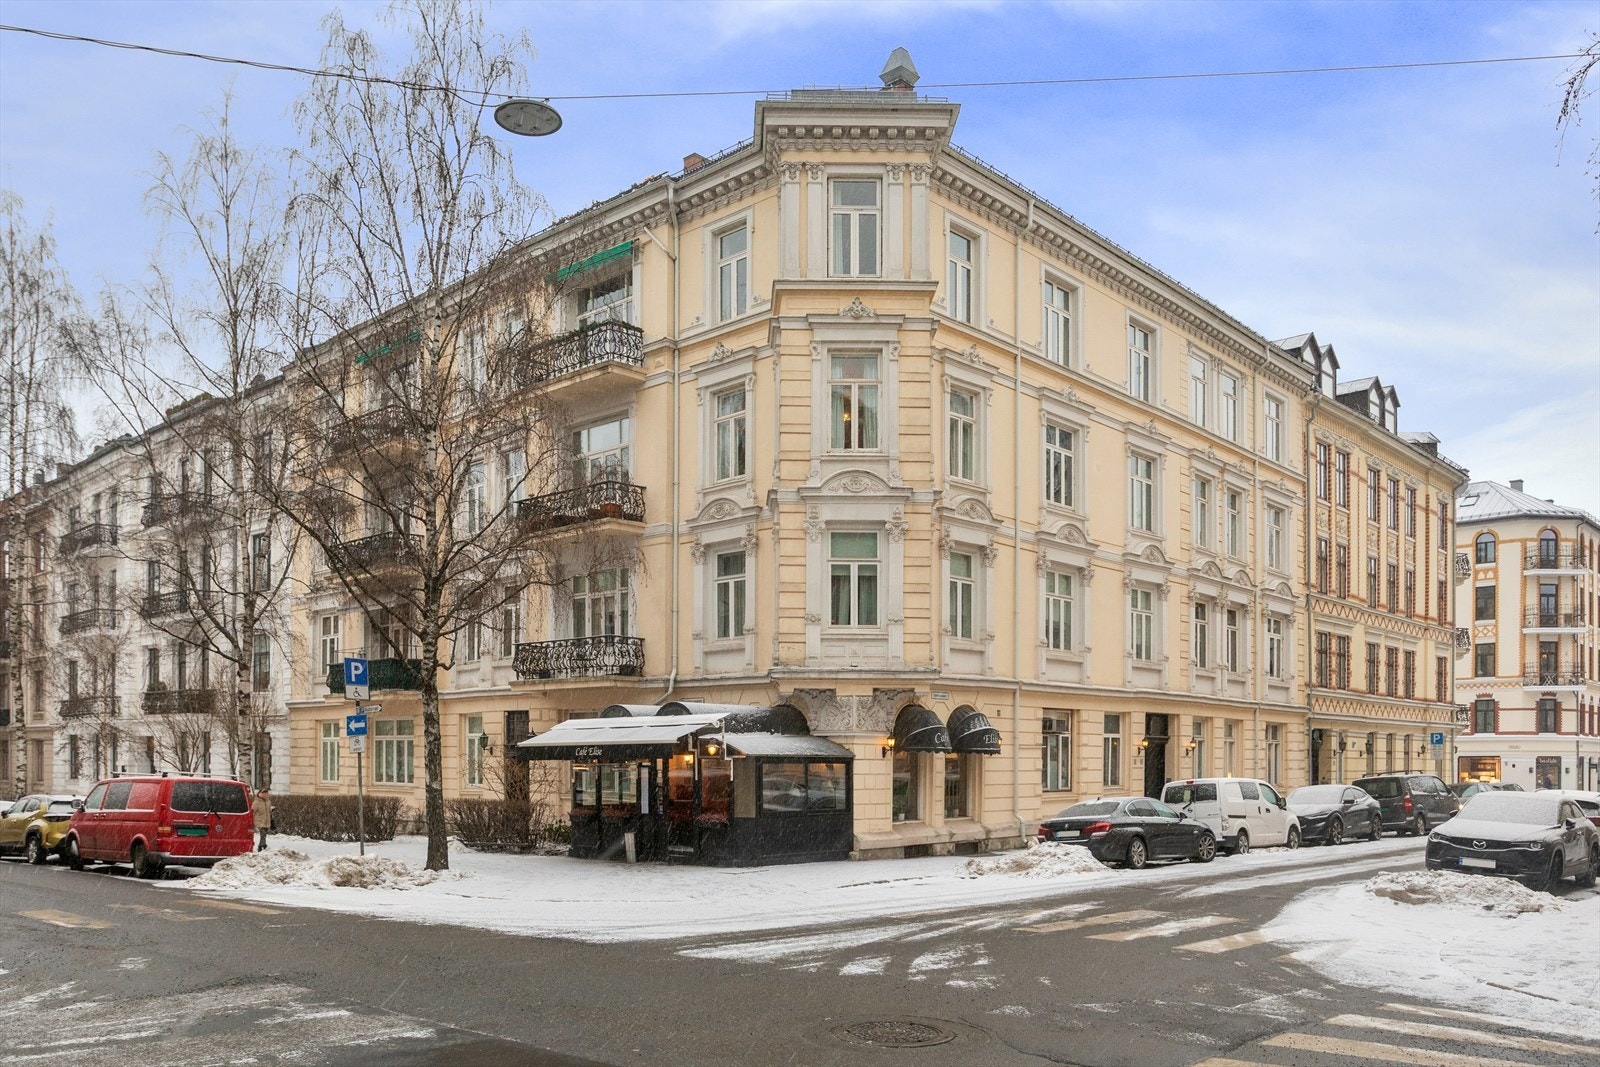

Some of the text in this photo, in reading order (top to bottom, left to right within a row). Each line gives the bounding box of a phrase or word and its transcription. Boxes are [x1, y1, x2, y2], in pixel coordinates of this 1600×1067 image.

[351, 661, 363, 681] P
[1434, 734, 1441, 744] P
[576, 746, 603, 758] Café Elise
